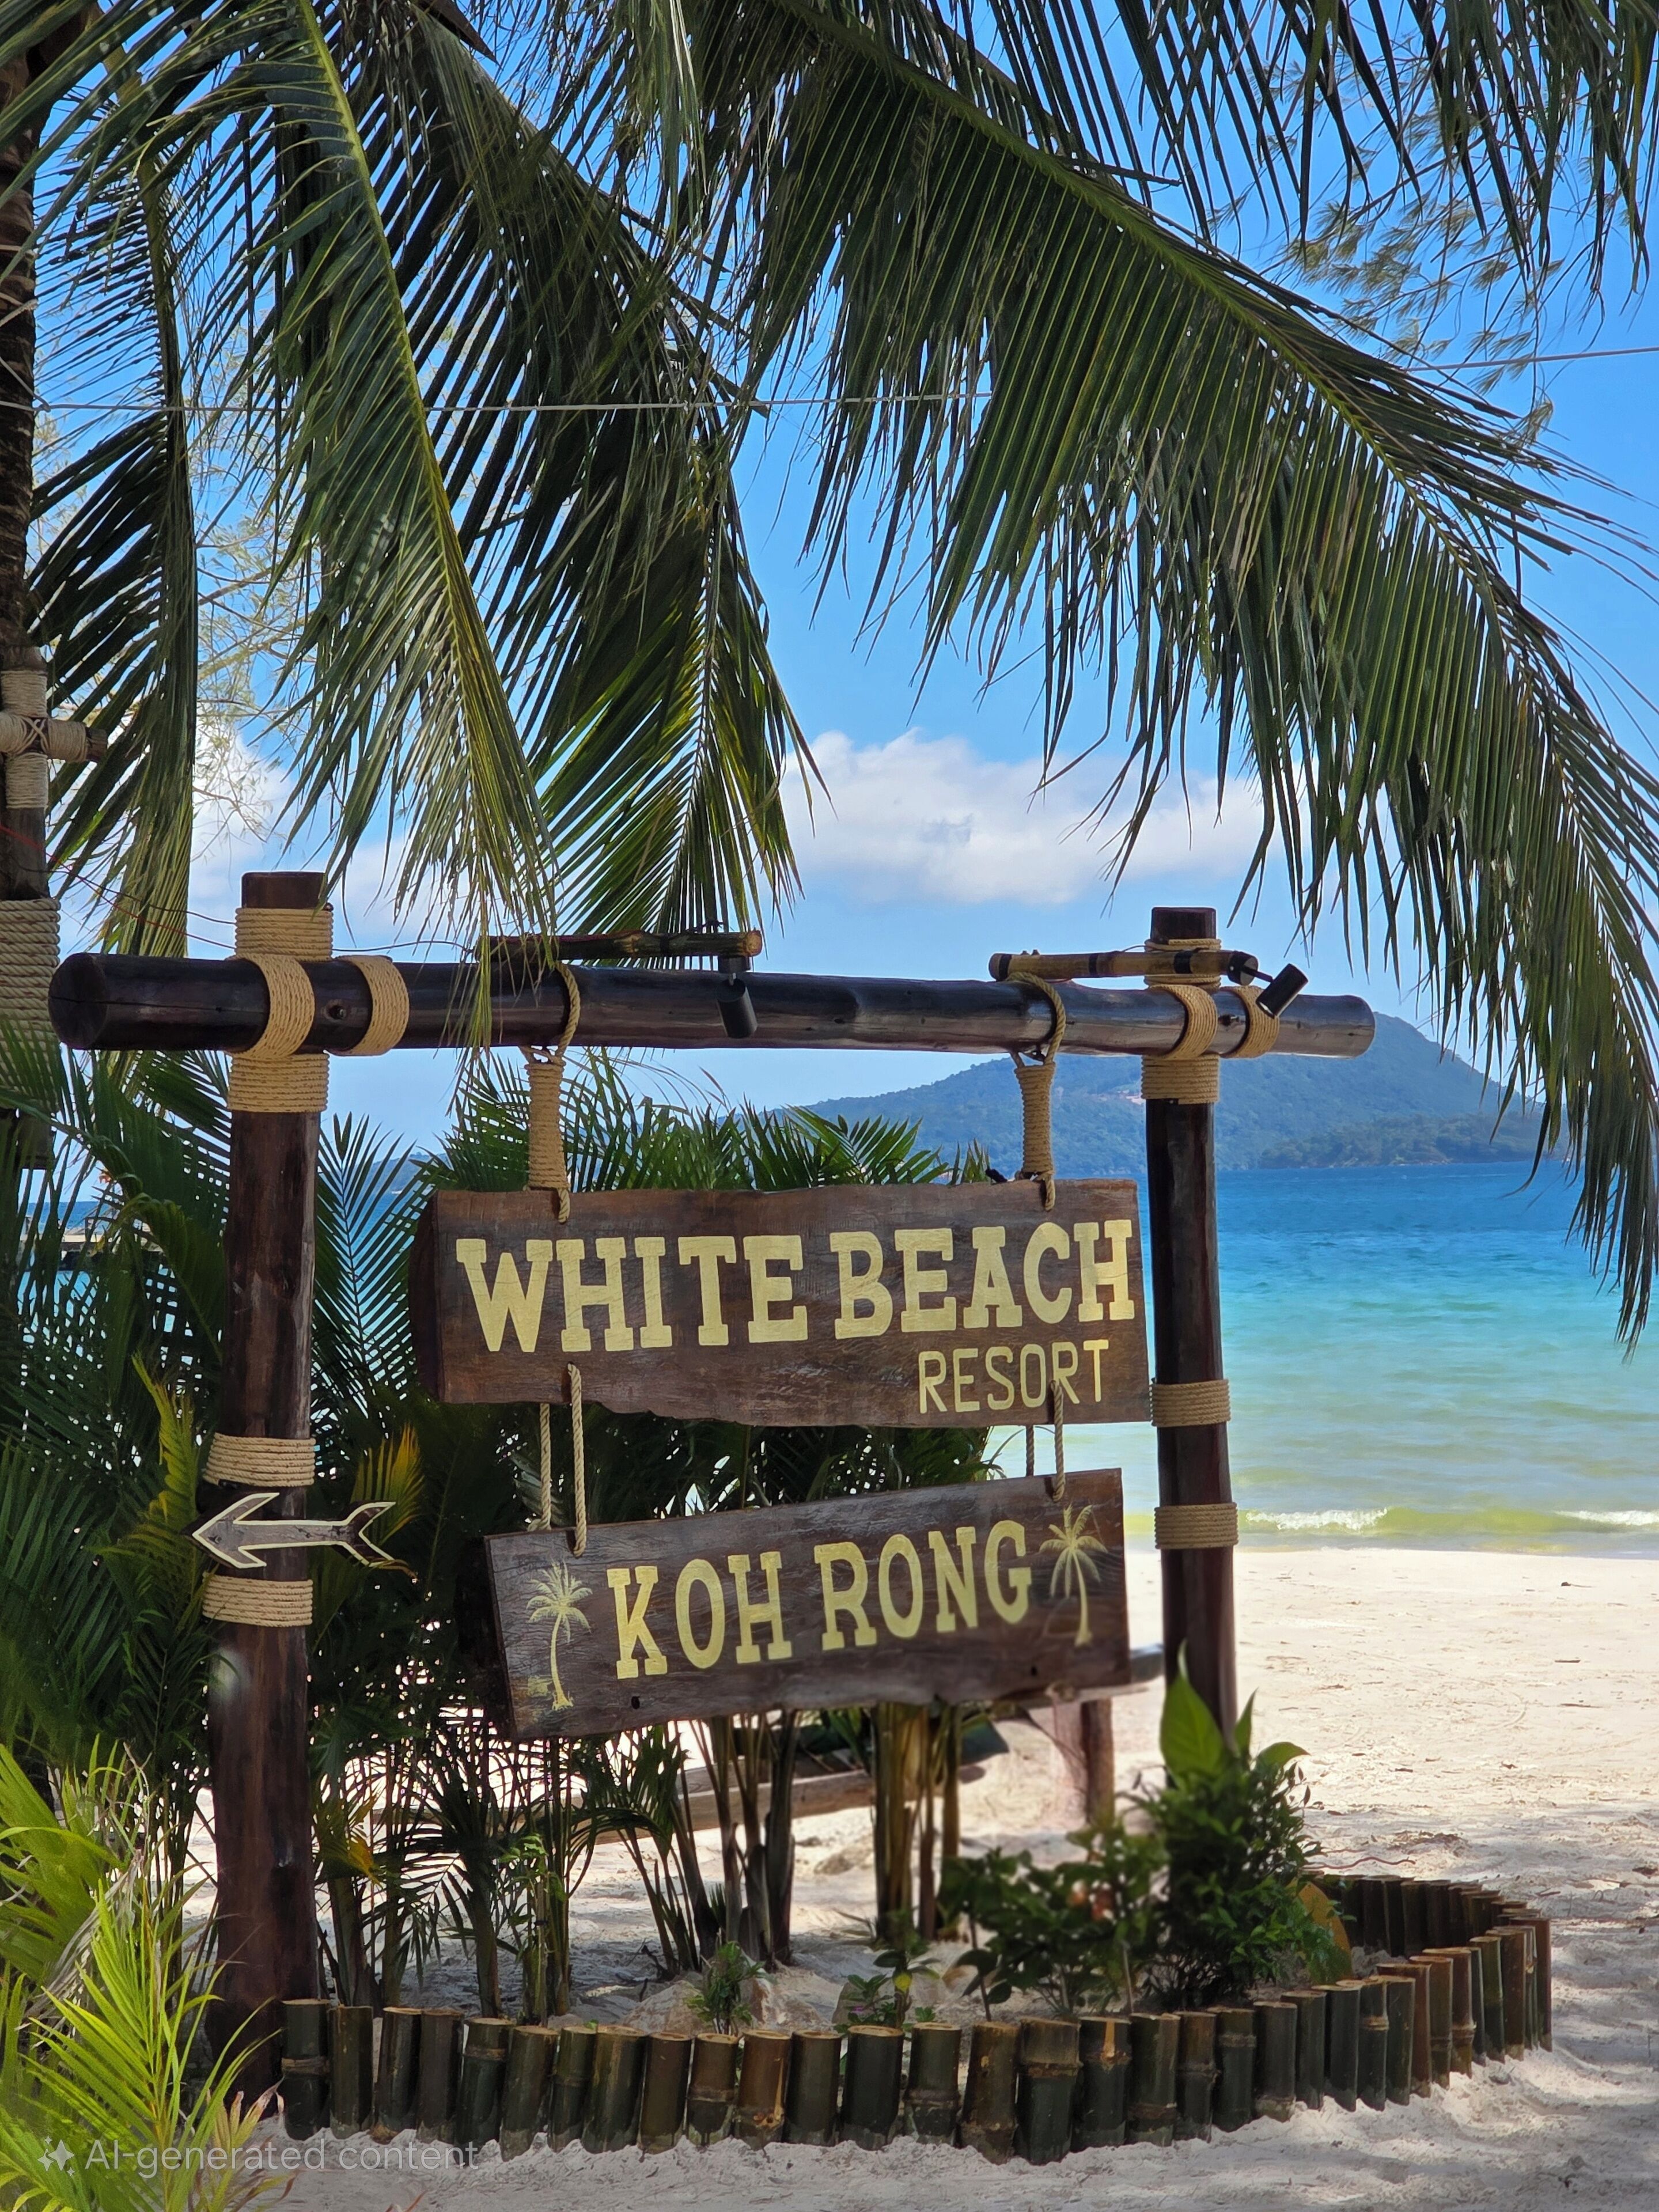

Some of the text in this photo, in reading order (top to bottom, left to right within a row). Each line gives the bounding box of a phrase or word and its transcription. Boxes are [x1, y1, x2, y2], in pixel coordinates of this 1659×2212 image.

[456, 1219, 1135, 1353] WHITE BEACH
[918, 1339, 1109, 1414] RESORT
[606, 1520, 1032, 1680] KOH RONG
